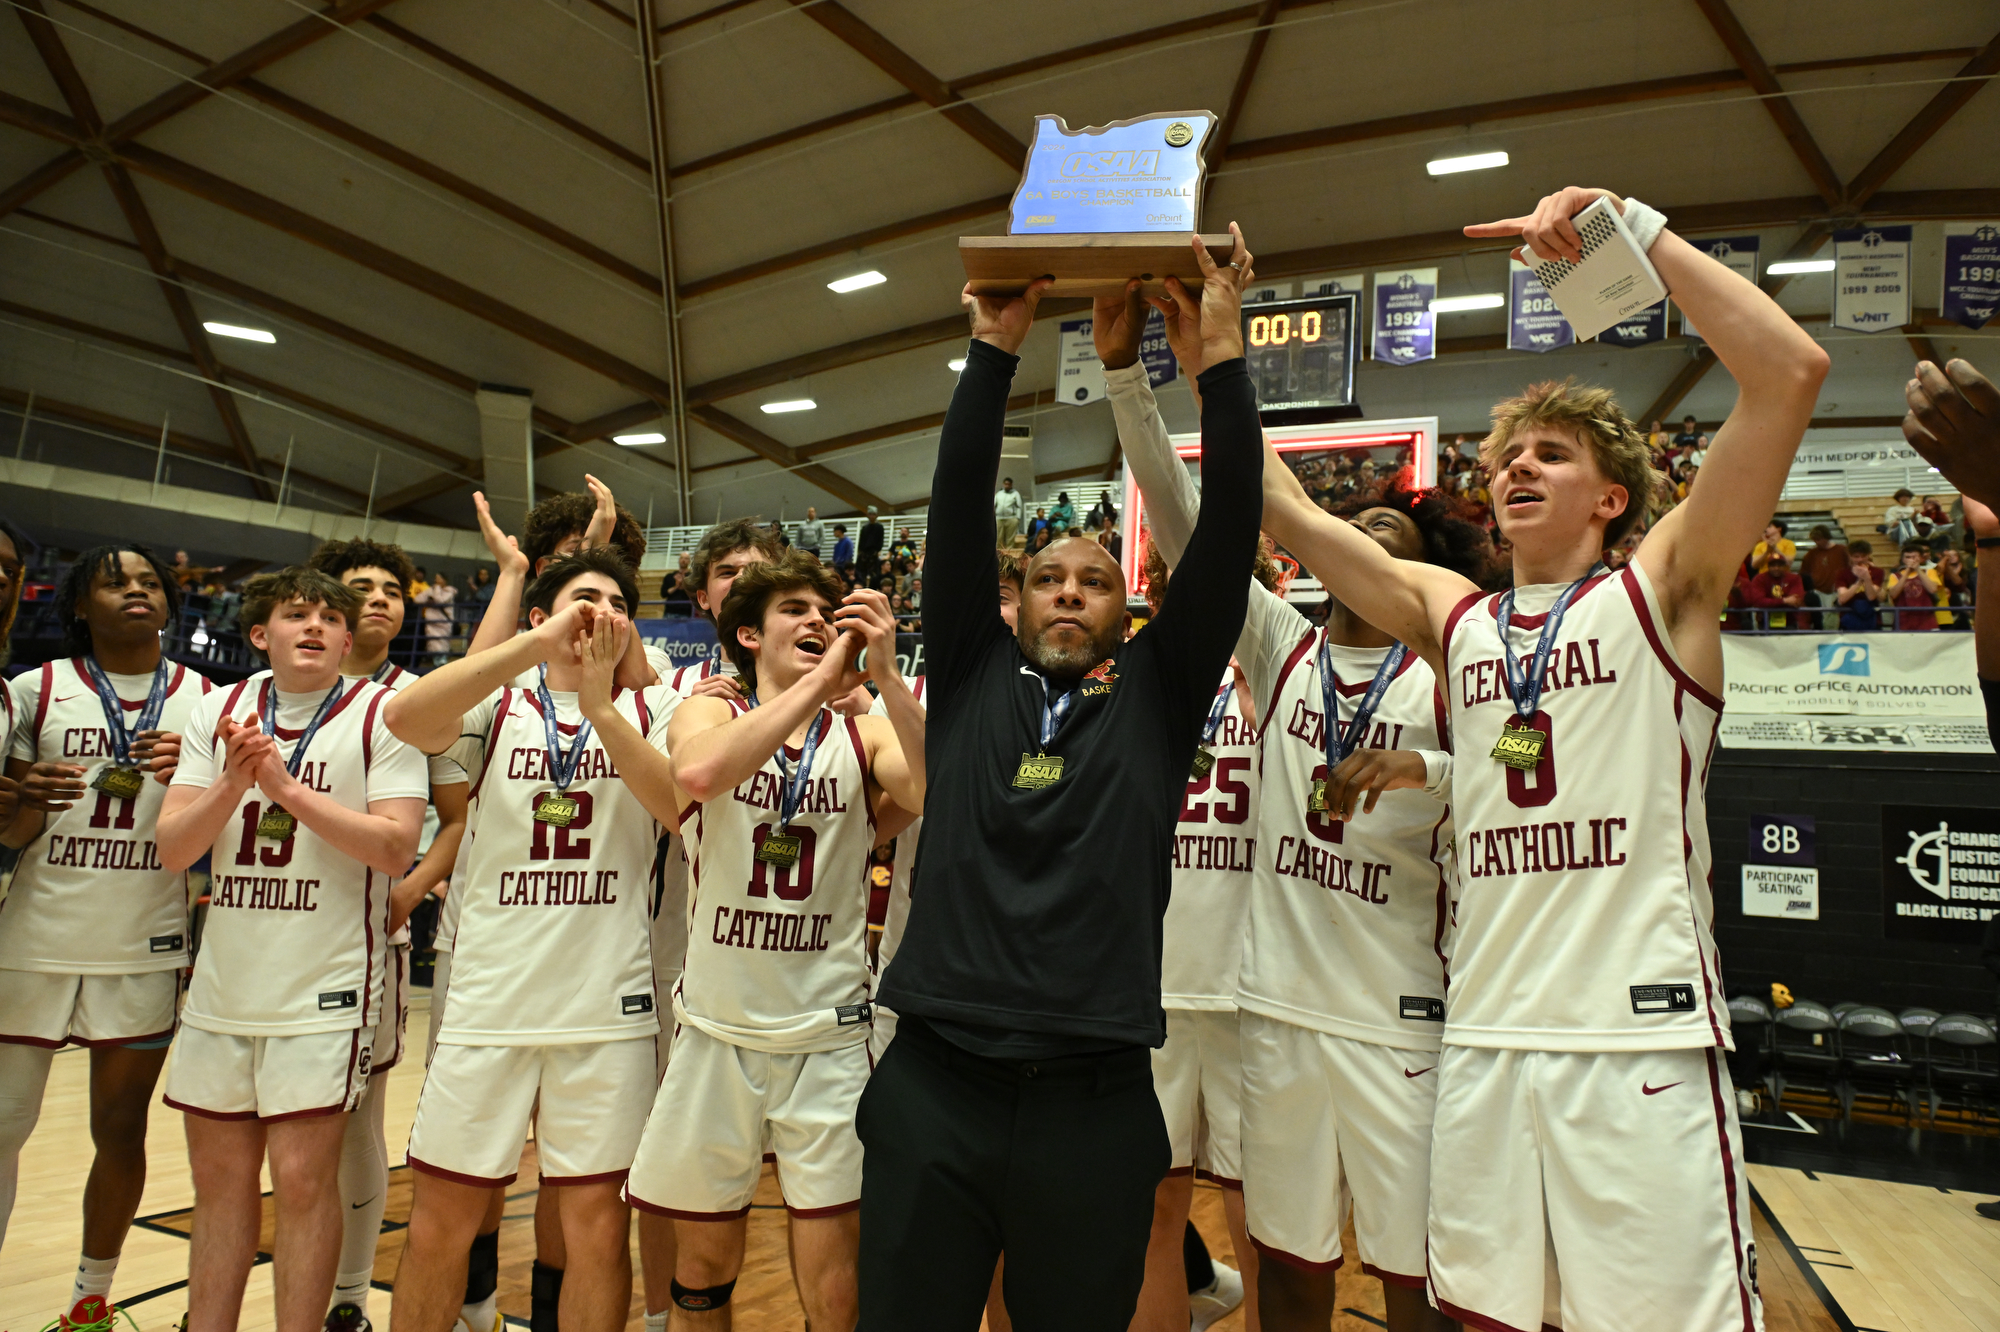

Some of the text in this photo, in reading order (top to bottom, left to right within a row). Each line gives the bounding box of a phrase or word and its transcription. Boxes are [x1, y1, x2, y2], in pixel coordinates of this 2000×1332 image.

[1060, 150, 1161, 178] OSAA
[1025, 188, 1192, 200] 6A BOYS BASKETBALL
[1079, 198, 1134, 207] CHAMPION
[1025, 215, 1056, 223] OSAA
[1146, 213, 1182, 222] OnPoint
[1386, 311, 1423, 327] 1997
[1852, 312, 1891, 323] WNIT
[1250, 311, 1322, 346] 00.0
[1616, 325, 1648, 337] WCC
[1528, 333, 1556, 343] WCC
[1262, 401, 1320, 410] DAKTRONICS
[1729, 681, 1973, 696] PACIFIC OFFICE AUTOMATION
[1787, 697, 1926, 709] PROBLEM SOLVED
[1497, 737, 1541, 756] OSAA
[1504, 709, 1557, 808] 0
[1020, 765, 1061, 780] OSAA
[540, 803, 573, 816] OSAA
[260, 821, 290, 830] OSAA
[529, 791, 594, 860] 12
[1762, 823, 1800, 853] 8B
[1949, 831, 2000, 848] CHANG
[763, 841, 797, 857] OSAA
[1469, 818, 1627, 878] CATHOLIC
[747, 822, 817, 901] 10
[1950, 849, 2000, 865] JUSTIC
[1746, 870, 1815, 884] PARTICIPANT
[213, 874, 320, 911] CATHOLIC
[499, 870, 618, 906] CATHOLIC
[1758, 883, 1803, 895] SEATING
[1896, 902, 1940, 918] BLACK
[1941, 905, 1978, 921] LIVES
[712, 905, 832, 952] CATHOLIC
[1675, 991, 1688, 1003] M
[1432, 1005, 1440, 1014] M
